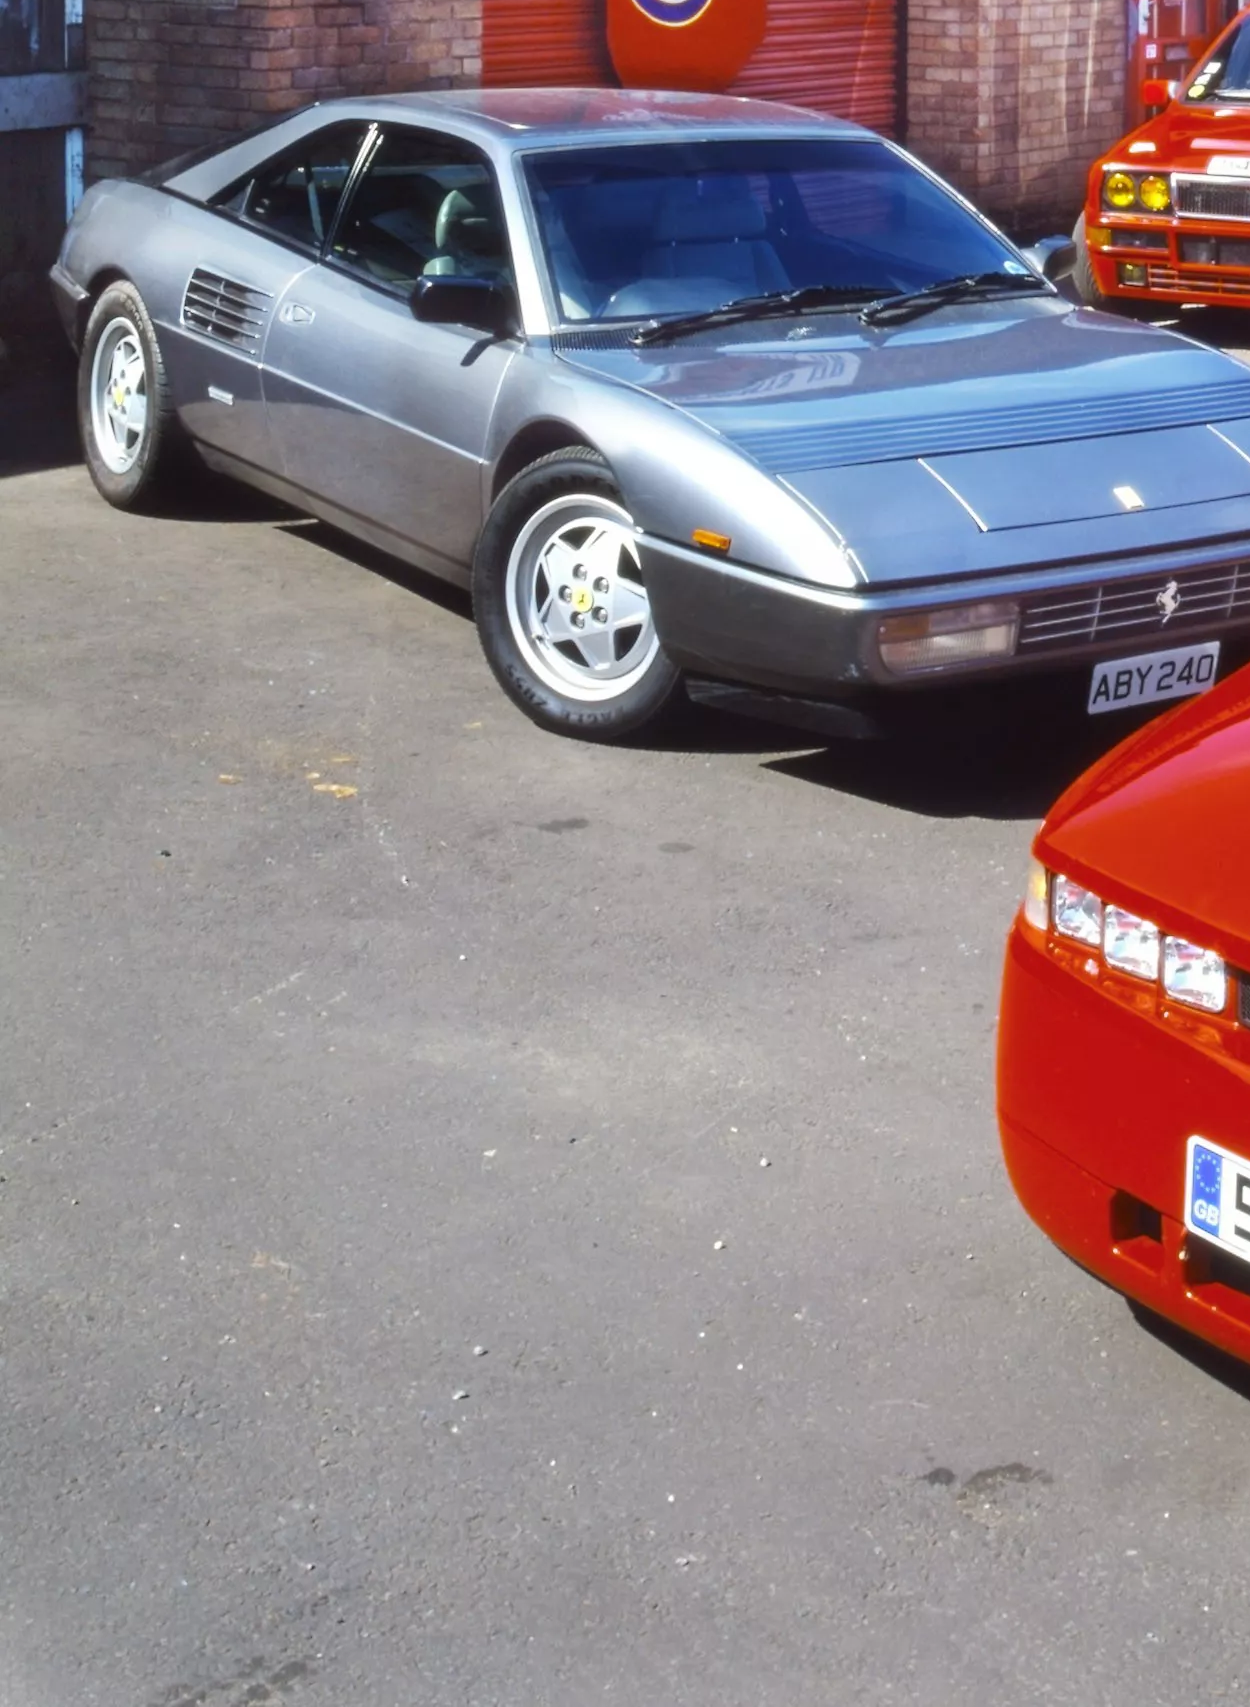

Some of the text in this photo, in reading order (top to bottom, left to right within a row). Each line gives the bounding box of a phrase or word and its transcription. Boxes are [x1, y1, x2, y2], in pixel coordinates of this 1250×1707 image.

[1093, 654, 1214, 705] ABY 240
[1194, 1199, 1219, 1226] GB
